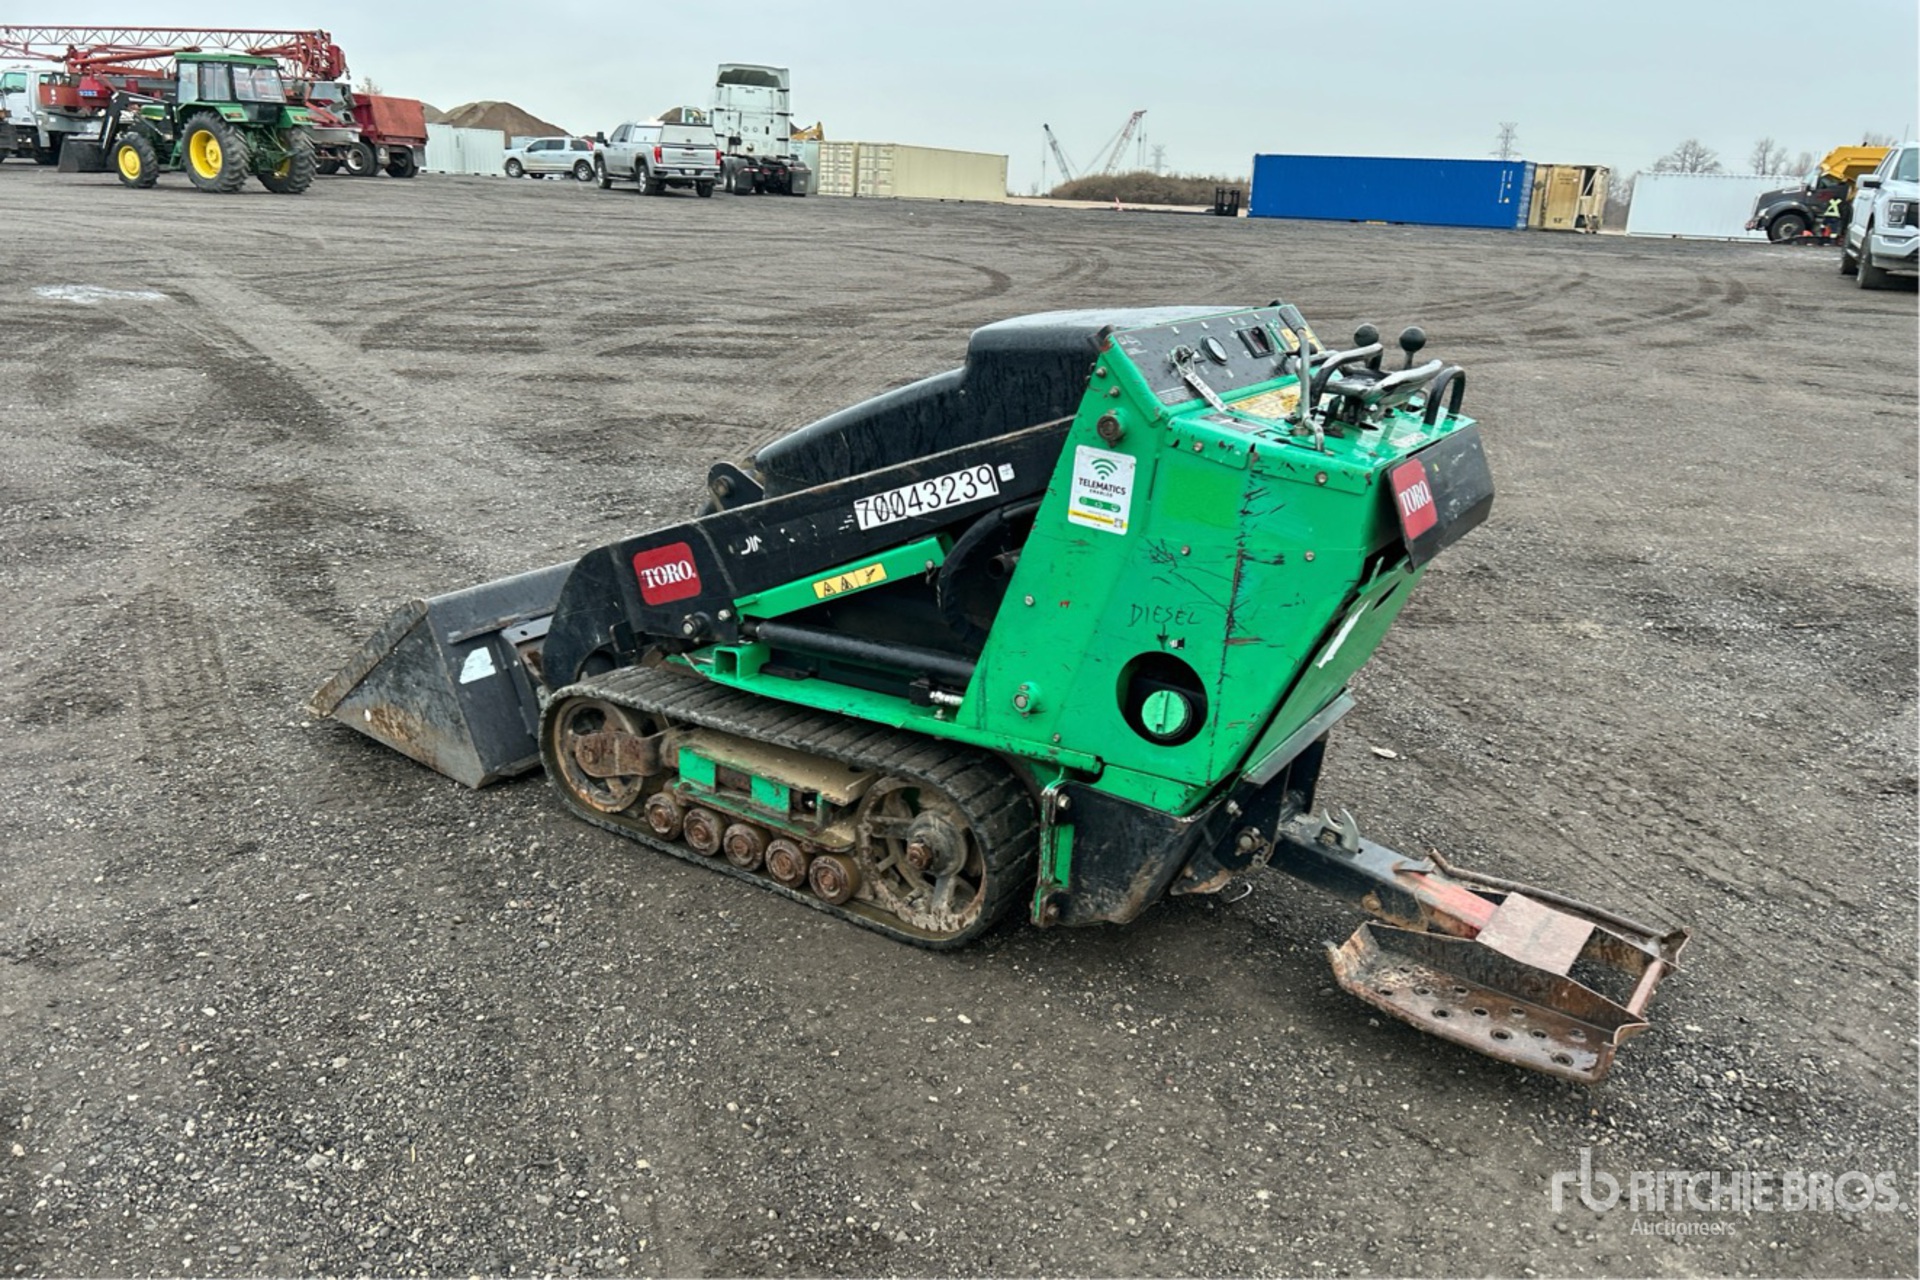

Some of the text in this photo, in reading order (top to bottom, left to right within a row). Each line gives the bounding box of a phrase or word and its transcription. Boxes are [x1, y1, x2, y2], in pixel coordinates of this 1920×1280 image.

[856, 466, 998, 527] 70043239
[1078, 477, 1127, 496] TELEMATICS
[1399, 480, 1430, 517] TORO
[641, 560, 694, 589] TORO
[1128, 603, 1202, 627] DIESEL
